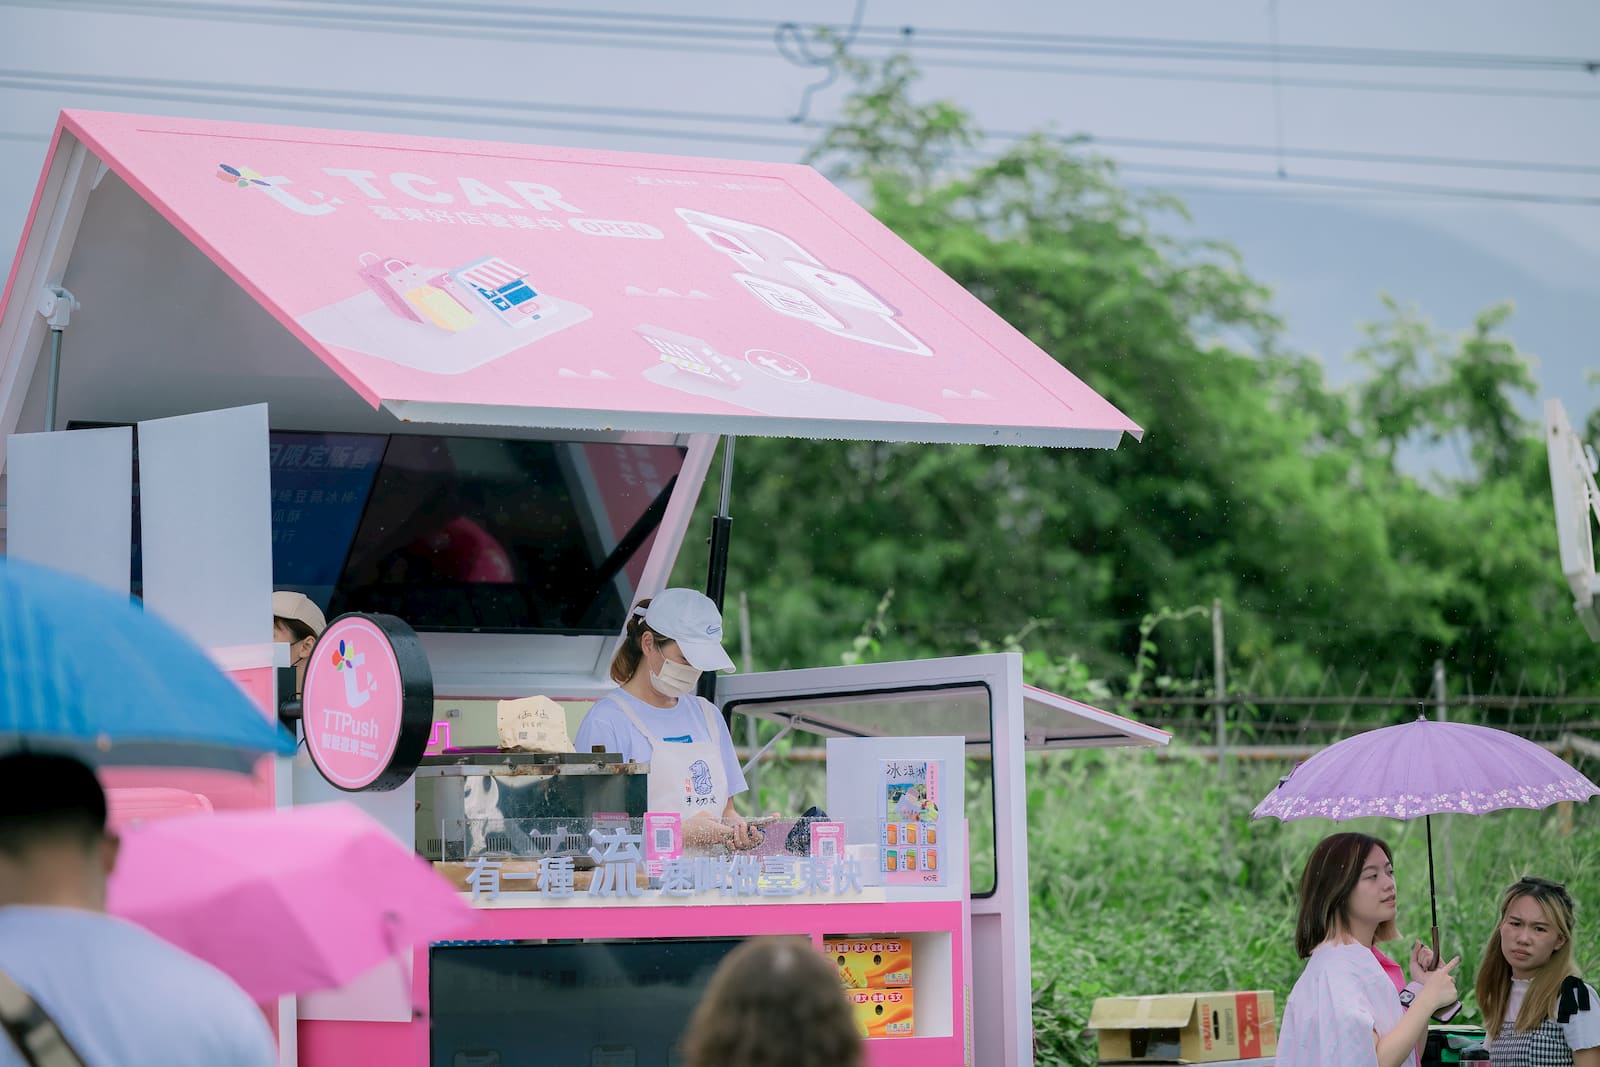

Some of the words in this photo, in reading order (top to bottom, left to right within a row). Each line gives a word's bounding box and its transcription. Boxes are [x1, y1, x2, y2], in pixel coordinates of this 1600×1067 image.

[322, 166, 584, 214] TCAR
[580, 219, 656, 238] OPEN
[322, 708, 379, 739] TTPush
